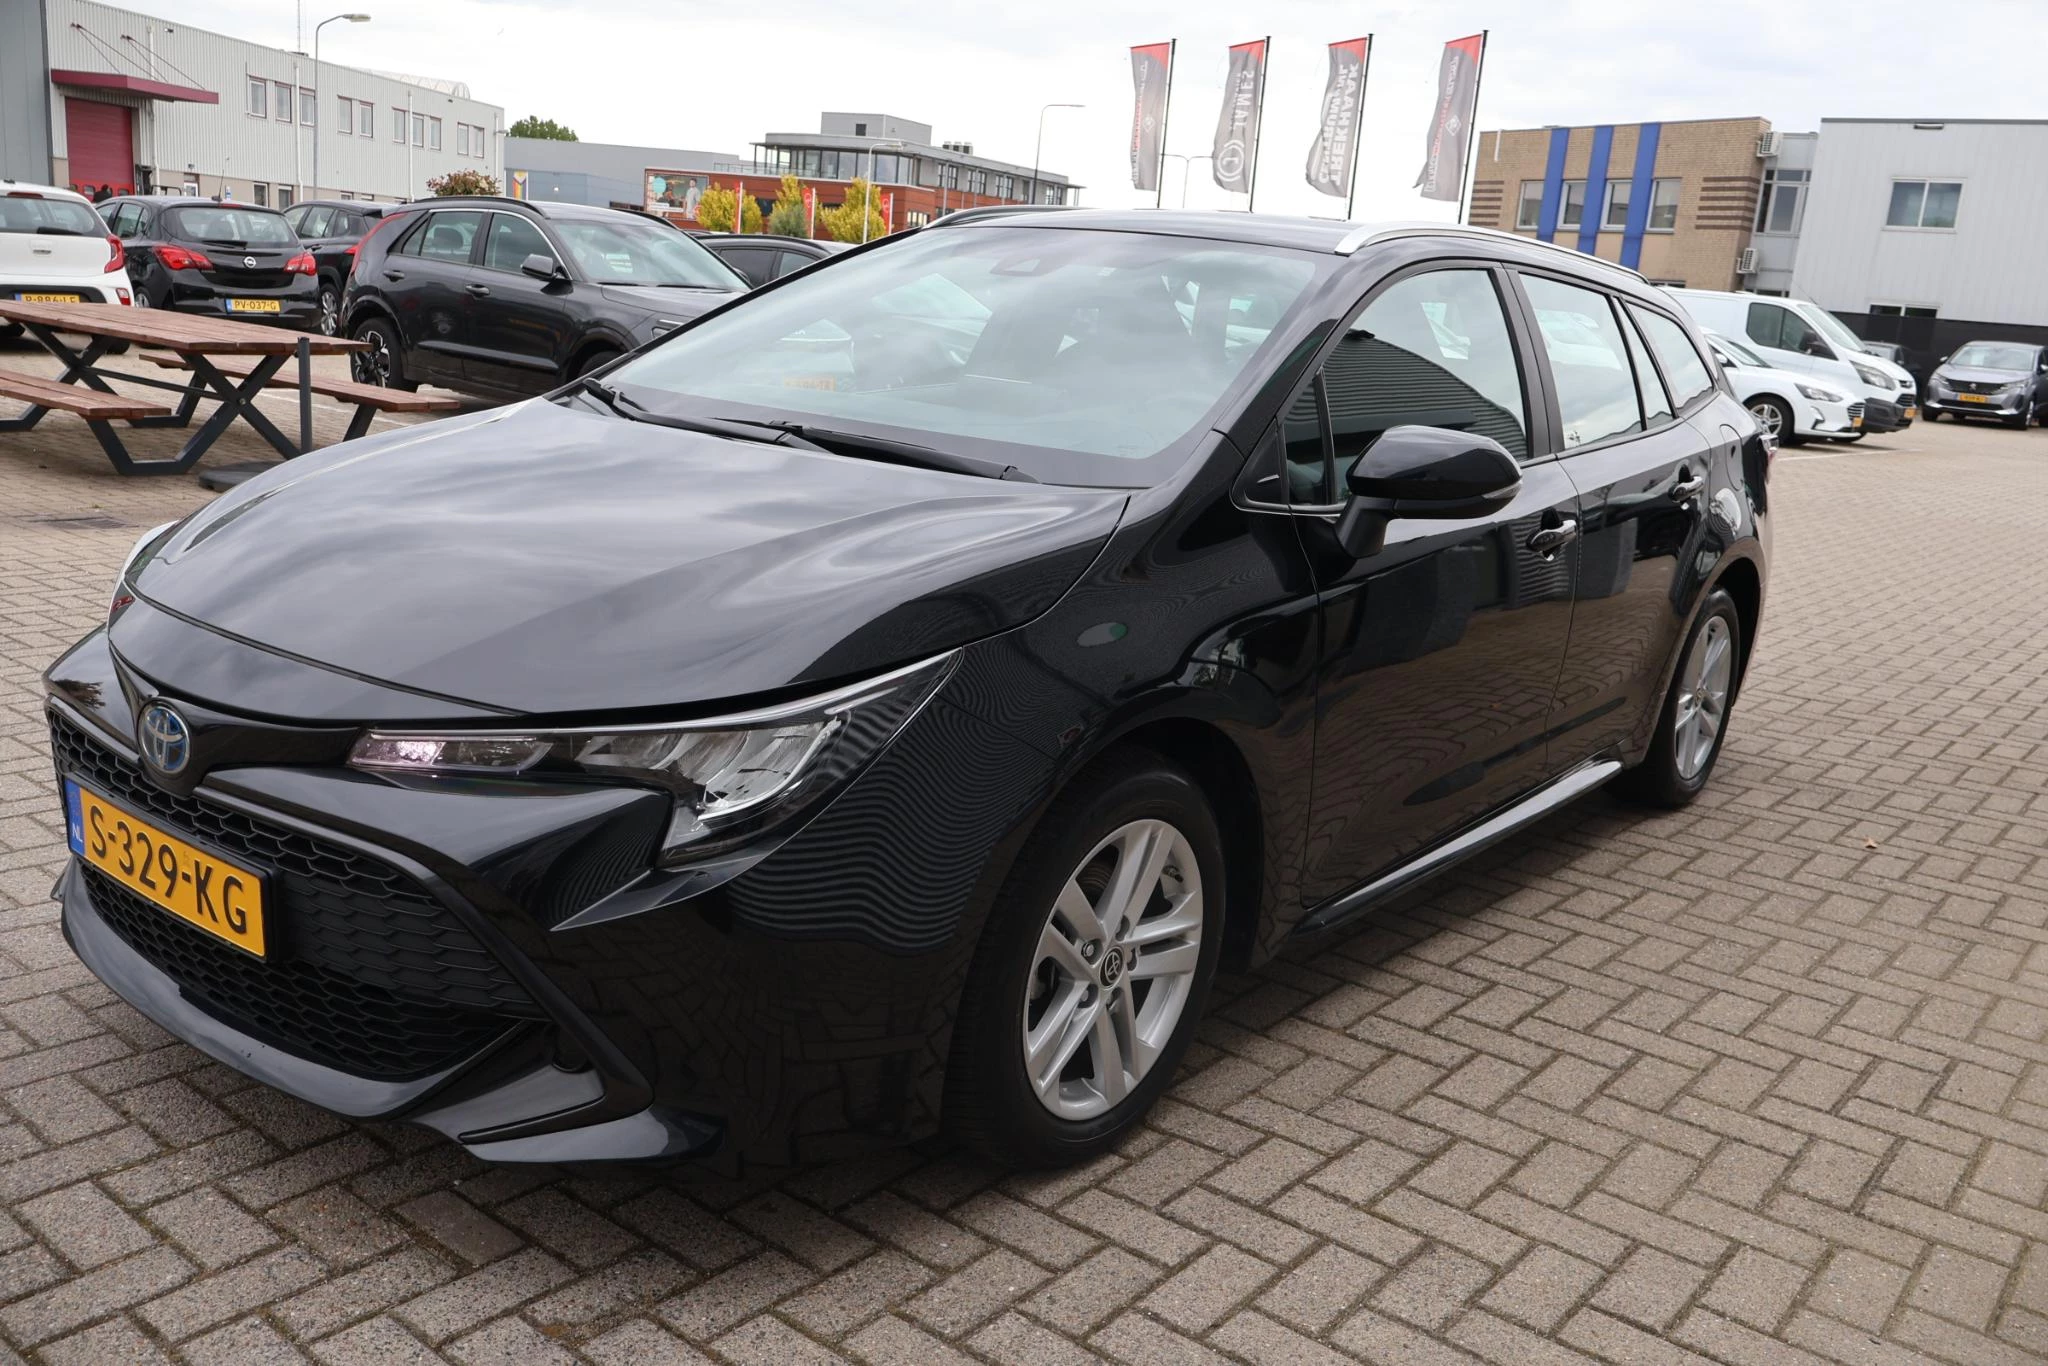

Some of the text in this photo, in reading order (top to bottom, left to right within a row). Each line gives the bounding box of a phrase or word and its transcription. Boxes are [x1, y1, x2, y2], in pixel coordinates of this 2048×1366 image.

[234, 300, 277, 310] PV-037-G
[72, 822, 83, 843] NL
[89, 804, 248, 935] S-329-KG
